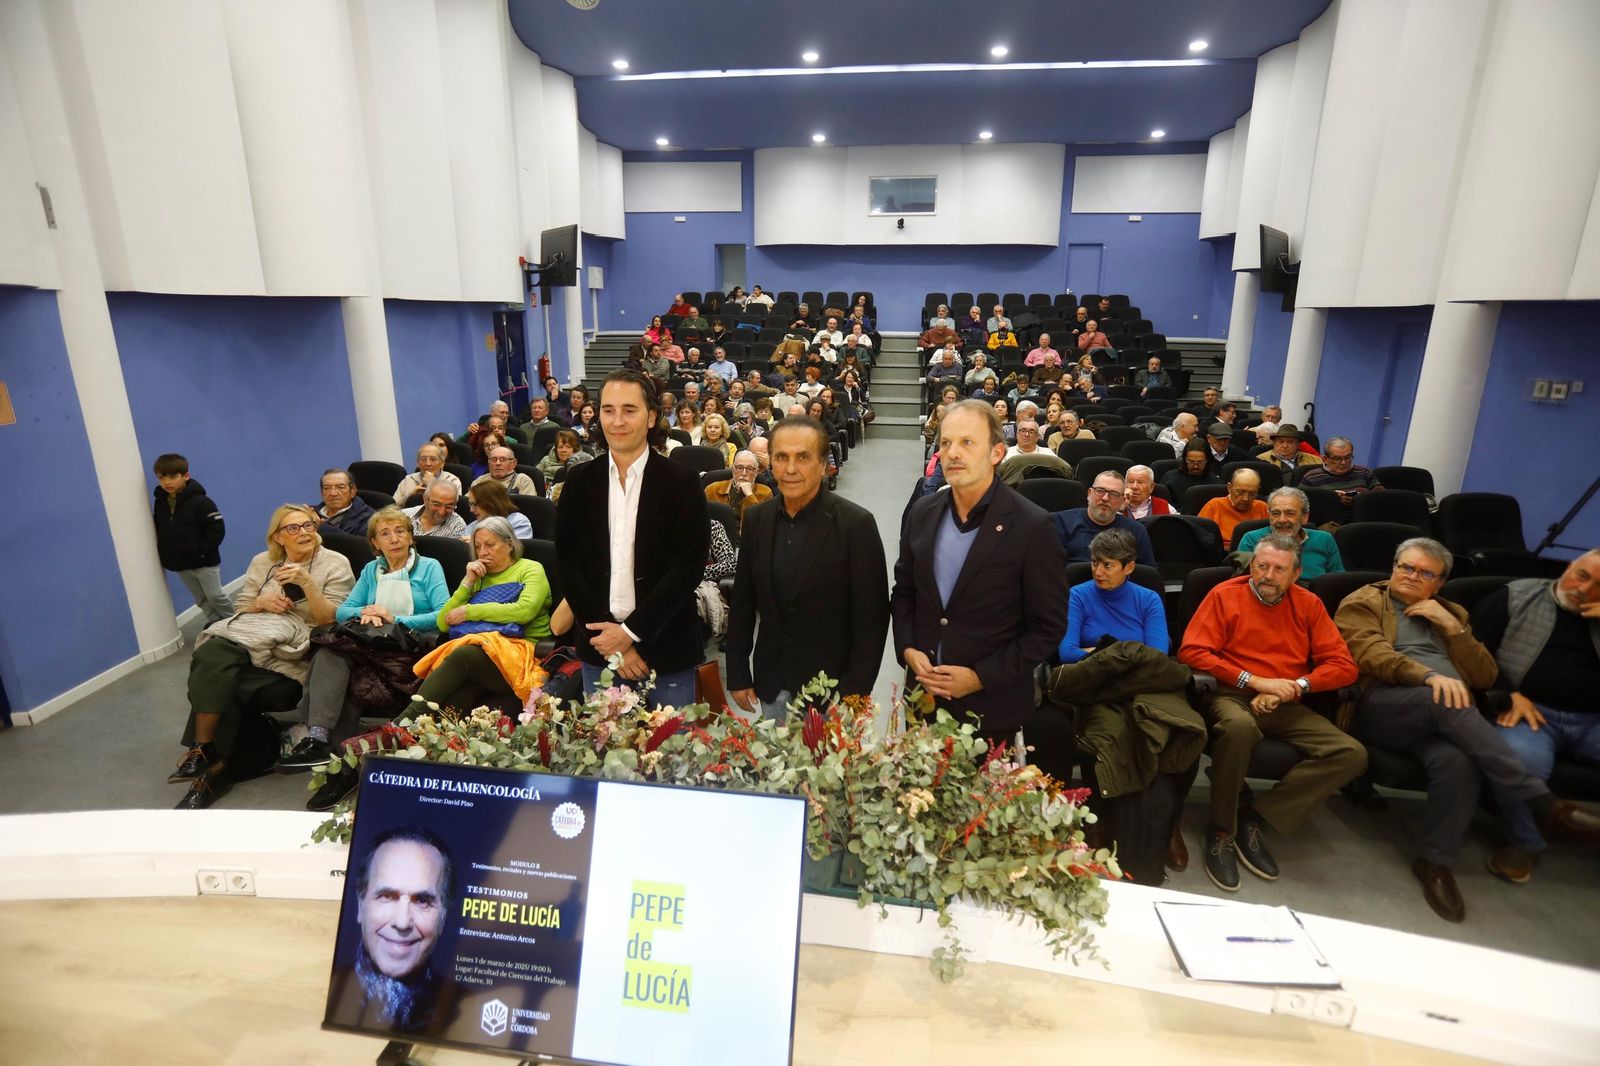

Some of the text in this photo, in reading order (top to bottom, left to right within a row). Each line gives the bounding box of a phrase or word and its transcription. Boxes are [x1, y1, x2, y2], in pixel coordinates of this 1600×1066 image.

[369, 771, 541, 800] CÁTEDRA DE FLAMENCOLOGÍA
[444, 798, 460, 806] David
[461, 800, 474, 808] Pino
[510, 860, 535, 869] MÓDULO
[544, 871, 577, 880] publicaciones
[467, 885, 528, 900] TESTIMONIOS
[462, 898, 560, 929] PEPE DE LUCÍA
[630, 892, 685, 925] PEPE
[459, 928, 536, 944] Entrevista: Antonio Arcos
[626, 932, 652, 961] de
[456, 955, 474, 963] Lunes
[479, 957, 487, 965] de
[506, 961, 514, 969] de
[531, 964, 547, 973] 19:00
[547, 966, 552, 974] h
[455, 964, 473, 974] Lugar:
[474, 967, 499, 977] Facultad
[508, 971, 532, 981] Ciencias
[533, 974, 543, 982] del
[544, 976, 567, 987] Trabajo
[623, 969, 690, 1007] LUCÍA
[512, 1008, 551, 1021] UNIVERSIDAD
[510, 1023, 538, 1035] CÓRDOBA
